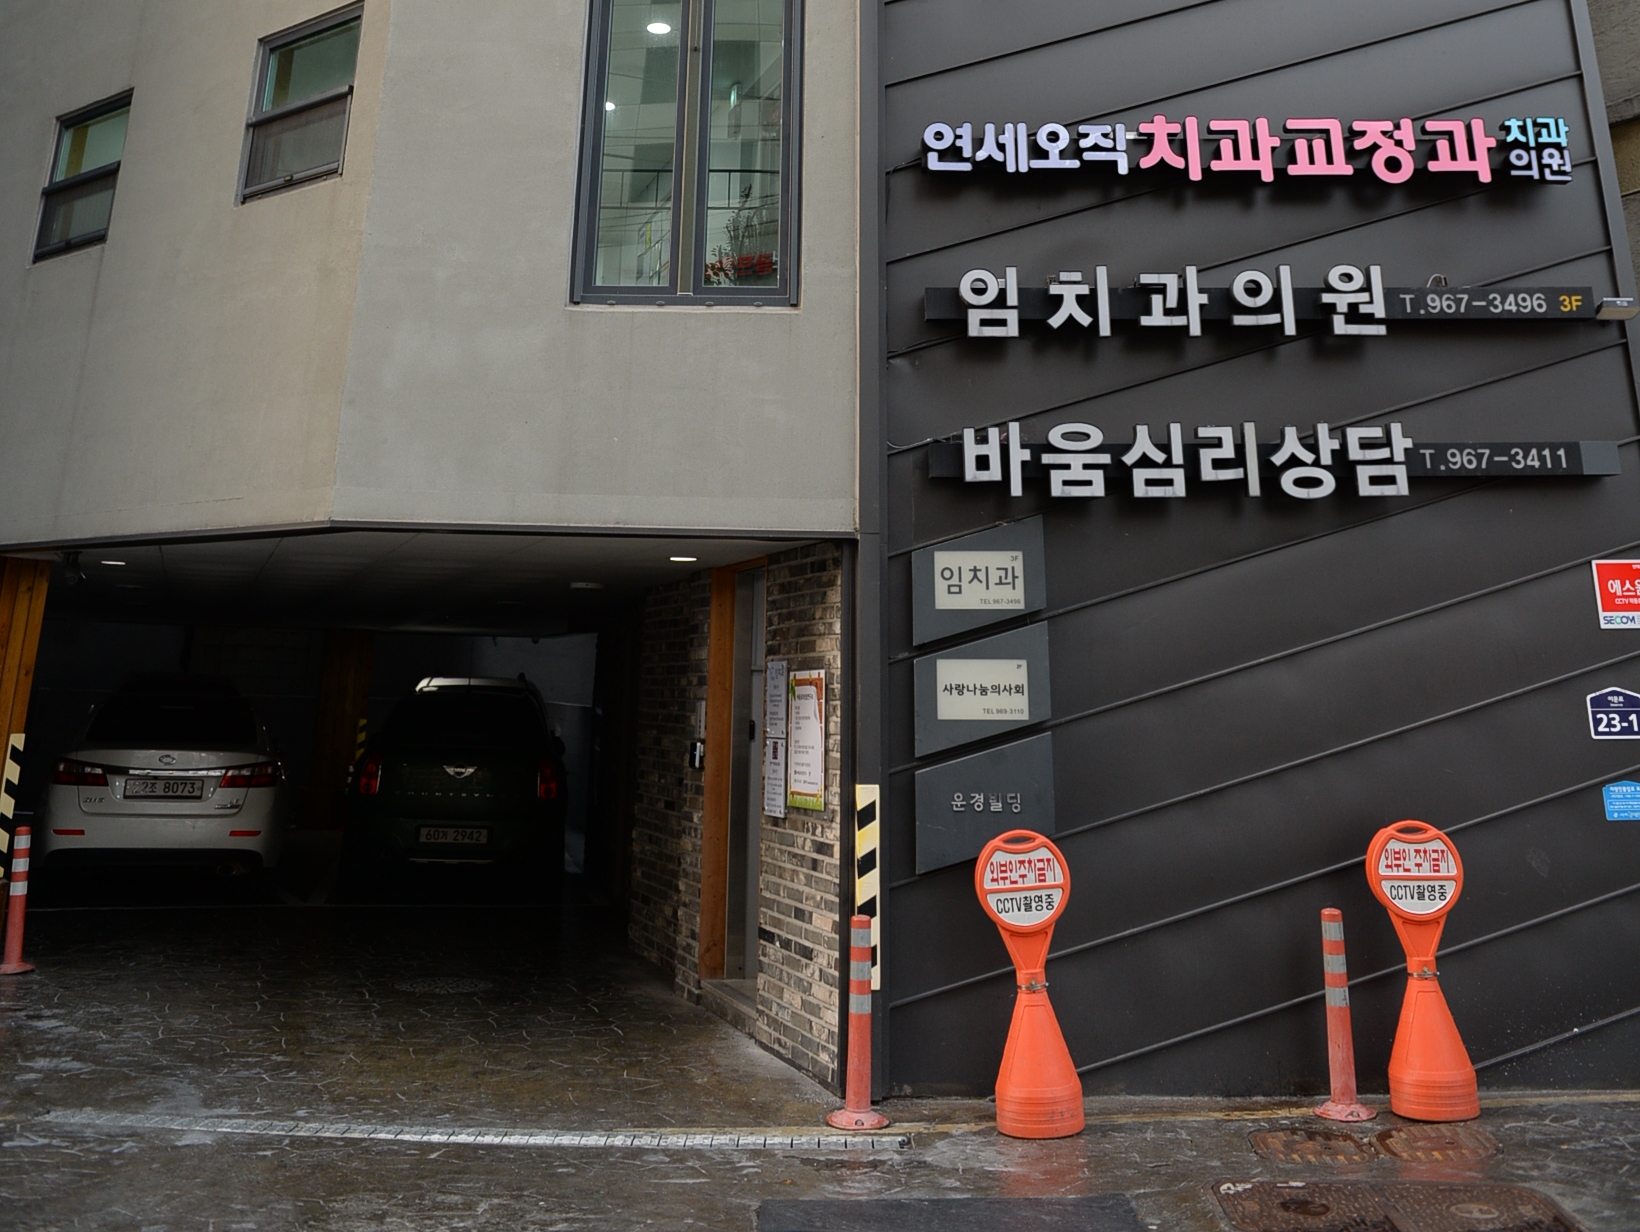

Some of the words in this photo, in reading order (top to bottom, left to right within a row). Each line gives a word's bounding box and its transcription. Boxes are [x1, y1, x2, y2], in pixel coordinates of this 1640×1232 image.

[1503, 117, 1569, 147] 치과
[1509, 147, 1573, 182] 의원
[1400, 293, 1548, 315] T.967-3496
[1558, 295, 1583, 312] 3F
[962, 421, 1414, 500] 바움심리상담
[1420, 447, 1568, 471] T.967-3411
[940, 565, 1020, 595] 임치과
[1602, 615, 1637, 625] SECOM
[942, 682, 1025, 697] 사랑나눔의사회
[982, 707, 995, 715] TEL
[1596, 713, 1639, 732] 23-1
[163, 781, 196, 794] 8073
[950, 792, 1022, 813] 운경빌딩
[453, 829, 482, 842] 2942
